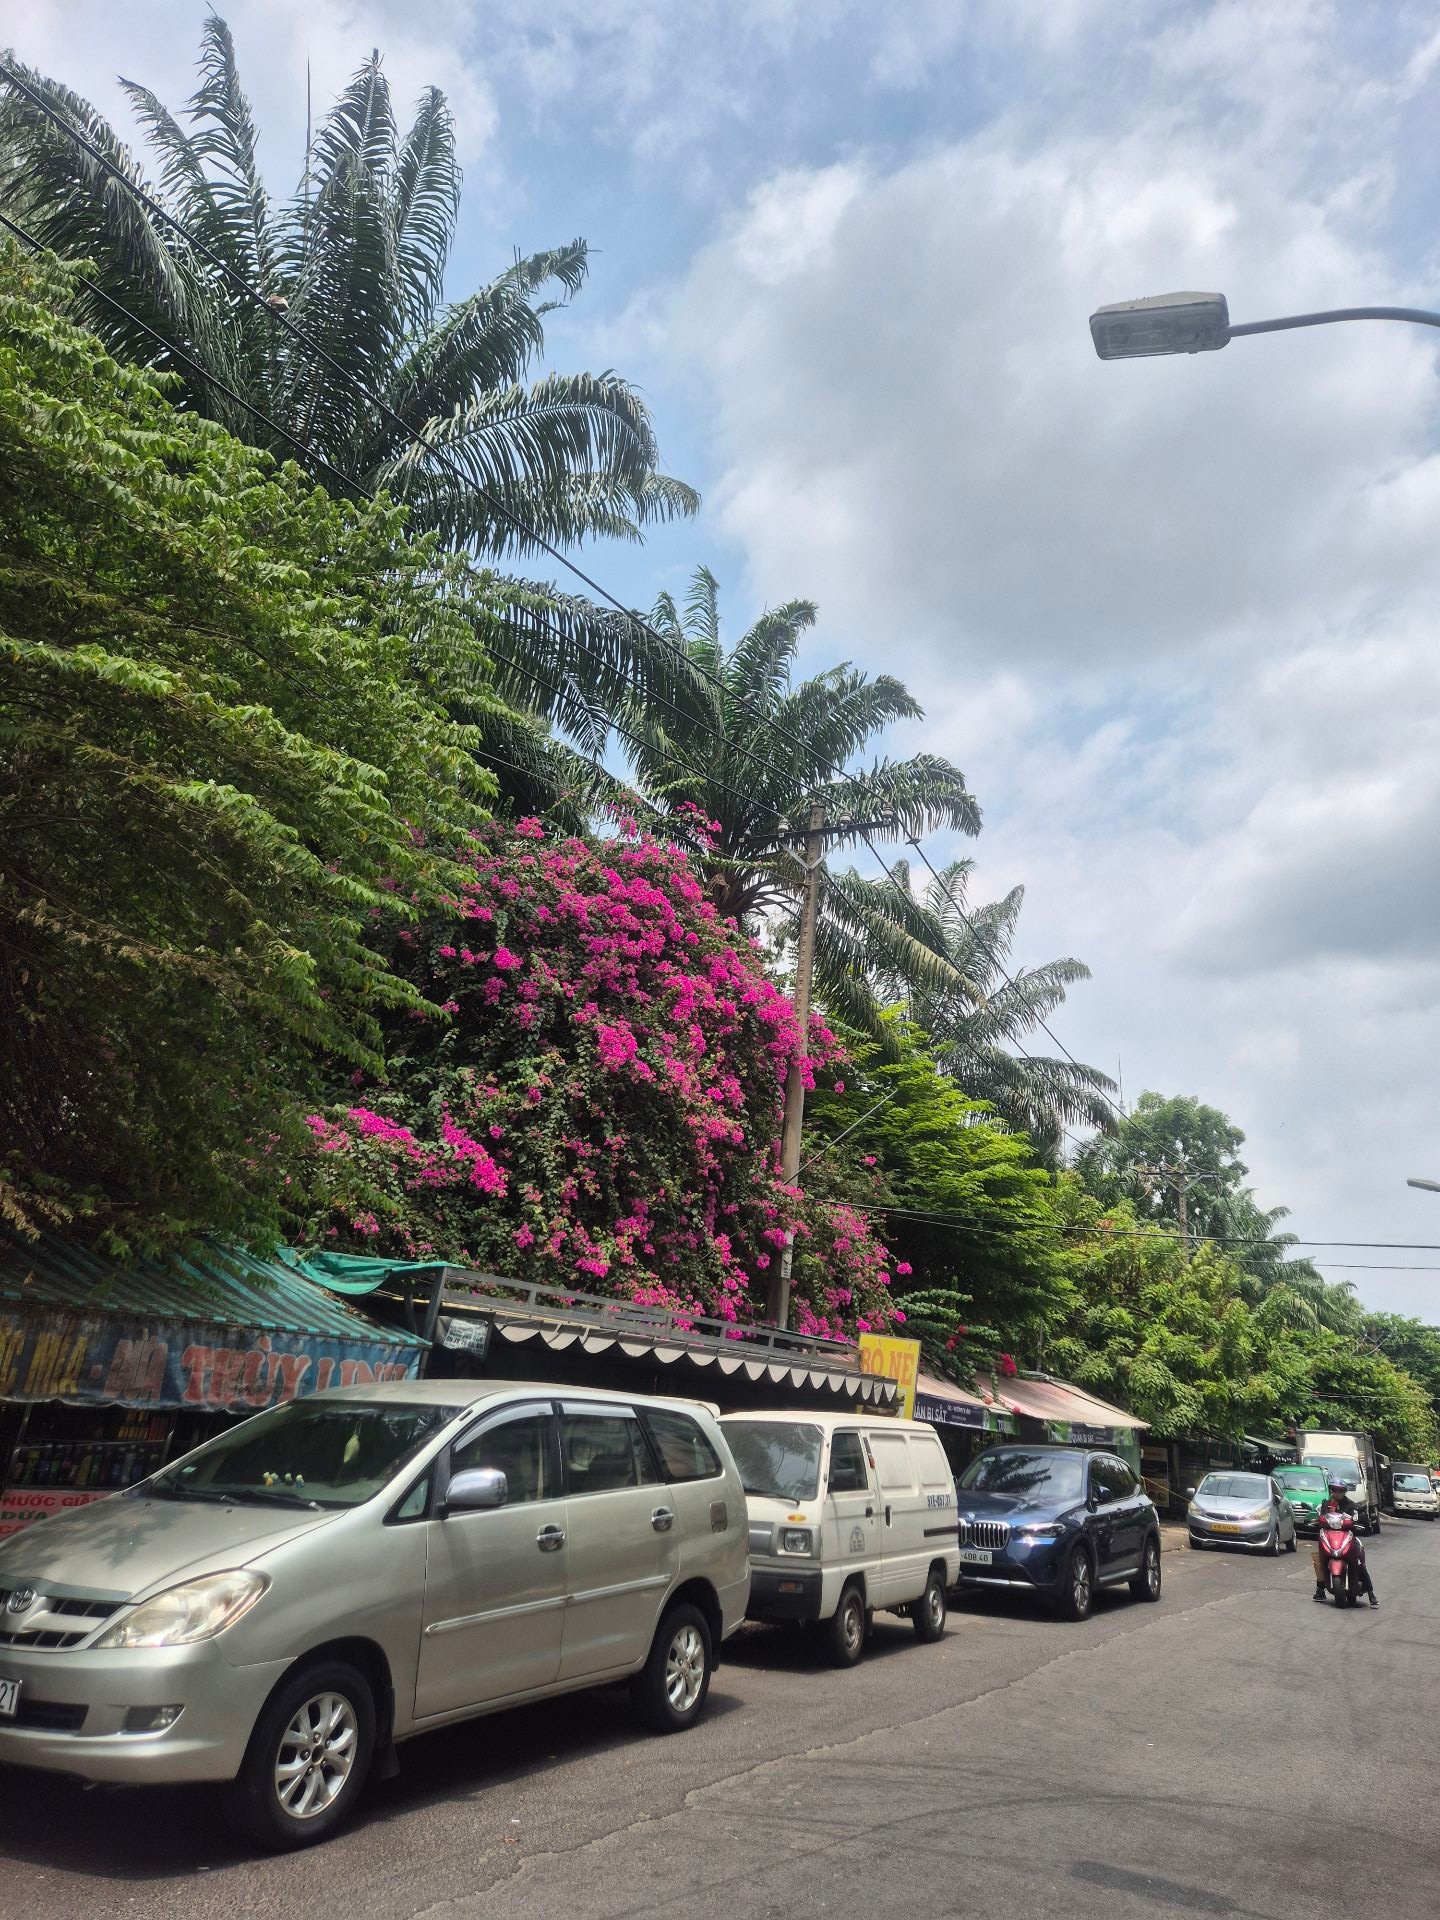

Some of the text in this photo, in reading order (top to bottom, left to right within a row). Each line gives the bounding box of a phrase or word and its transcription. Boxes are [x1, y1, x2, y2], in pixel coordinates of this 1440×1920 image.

[862, 1339, 914, 1386] BÒ NÉ
[3, 1494, 56, 1507] NƯỚC
